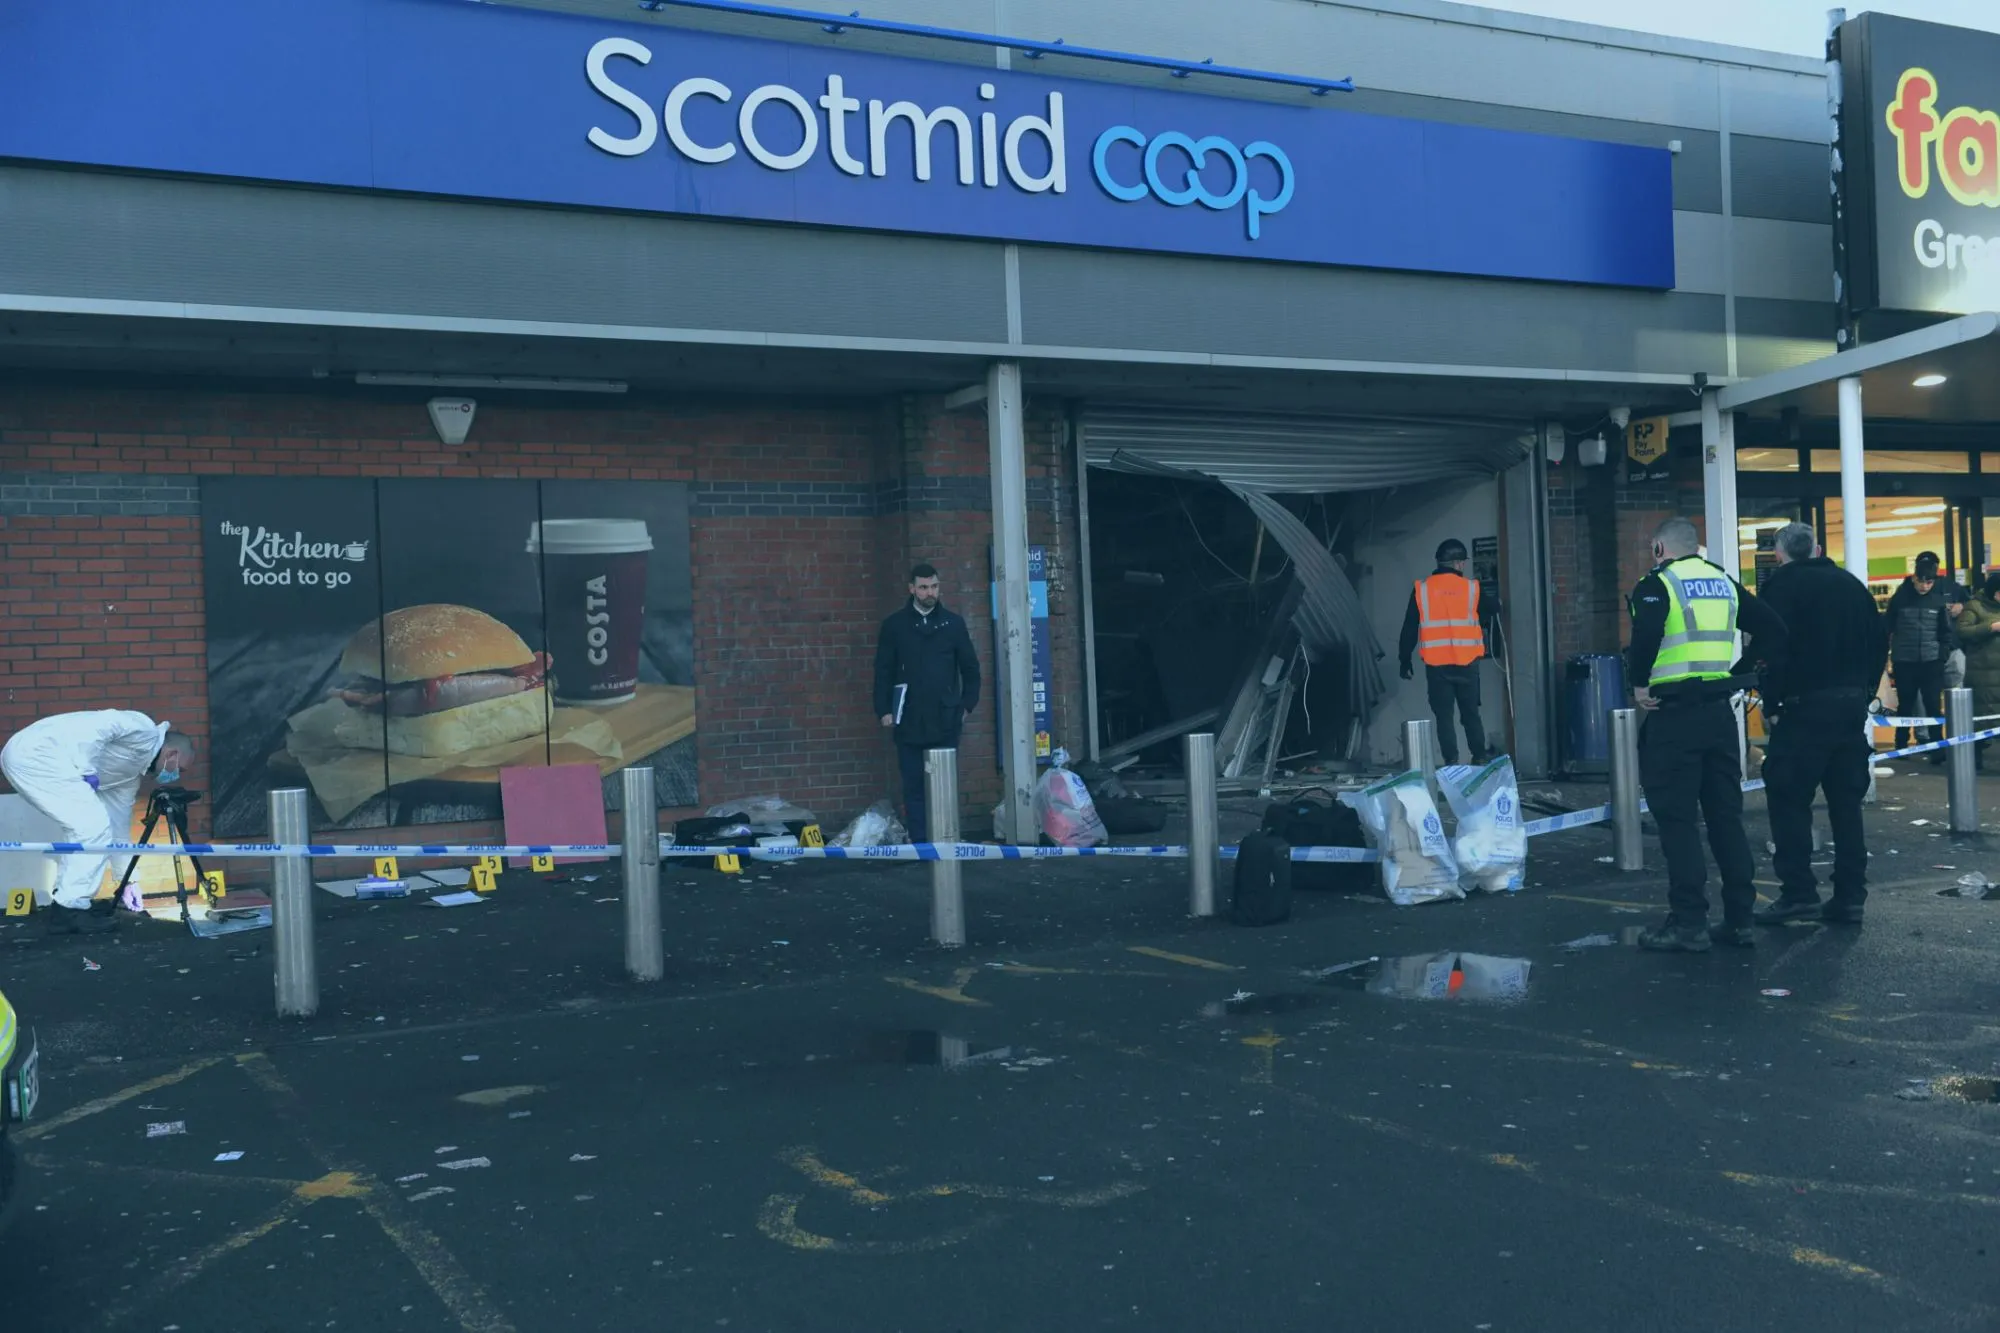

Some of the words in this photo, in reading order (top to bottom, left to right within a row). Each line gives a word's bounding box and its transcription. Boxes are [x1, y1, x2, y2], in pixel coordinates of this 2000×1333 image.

[586, 37, 1067, 193] Scotmid
[1093, 125, 1296, 239] coop
[220, 520, 242, 536] the
[239, 526, 346, 568] Kitchen
[242, 568, 291, 585] food
[297, 569, 319, 585] to
[325, 571, 352, 589] go
[1684, 580, 1730, 597] POLICE
[586, 574, 610, 666] COSTA
[808, 829, 822, 845] 10
[863, 846, 898, 857] POLICE
[955, 846, 986, 857] POLICE
[382, 862, 392, 877] 4
[487, 855, 496, 869] 5
[208, 876, 219, 896] 6
[478, 869, 488, 886] 7
[14, 893, 25, 911] 9
